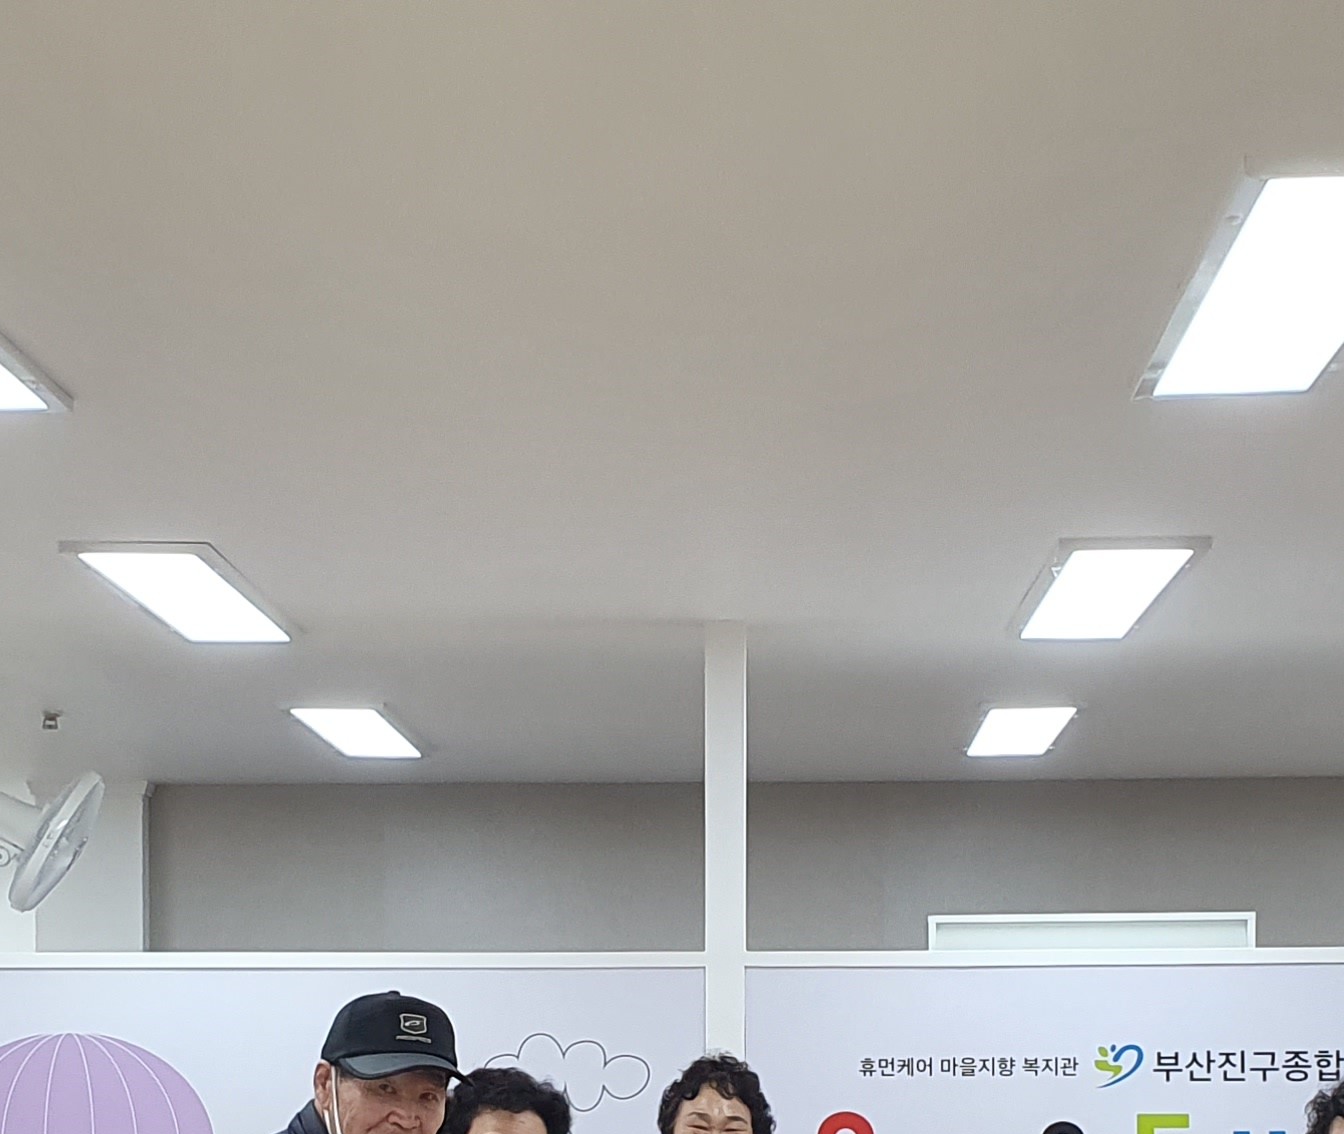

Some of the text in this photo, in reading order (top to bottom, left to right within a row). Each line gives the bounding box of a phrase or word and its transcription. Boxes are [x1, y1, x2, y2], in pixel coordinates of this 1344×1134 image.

[859, 1056, 1079, 1077] 휴먼케어 마을지향 복지관
